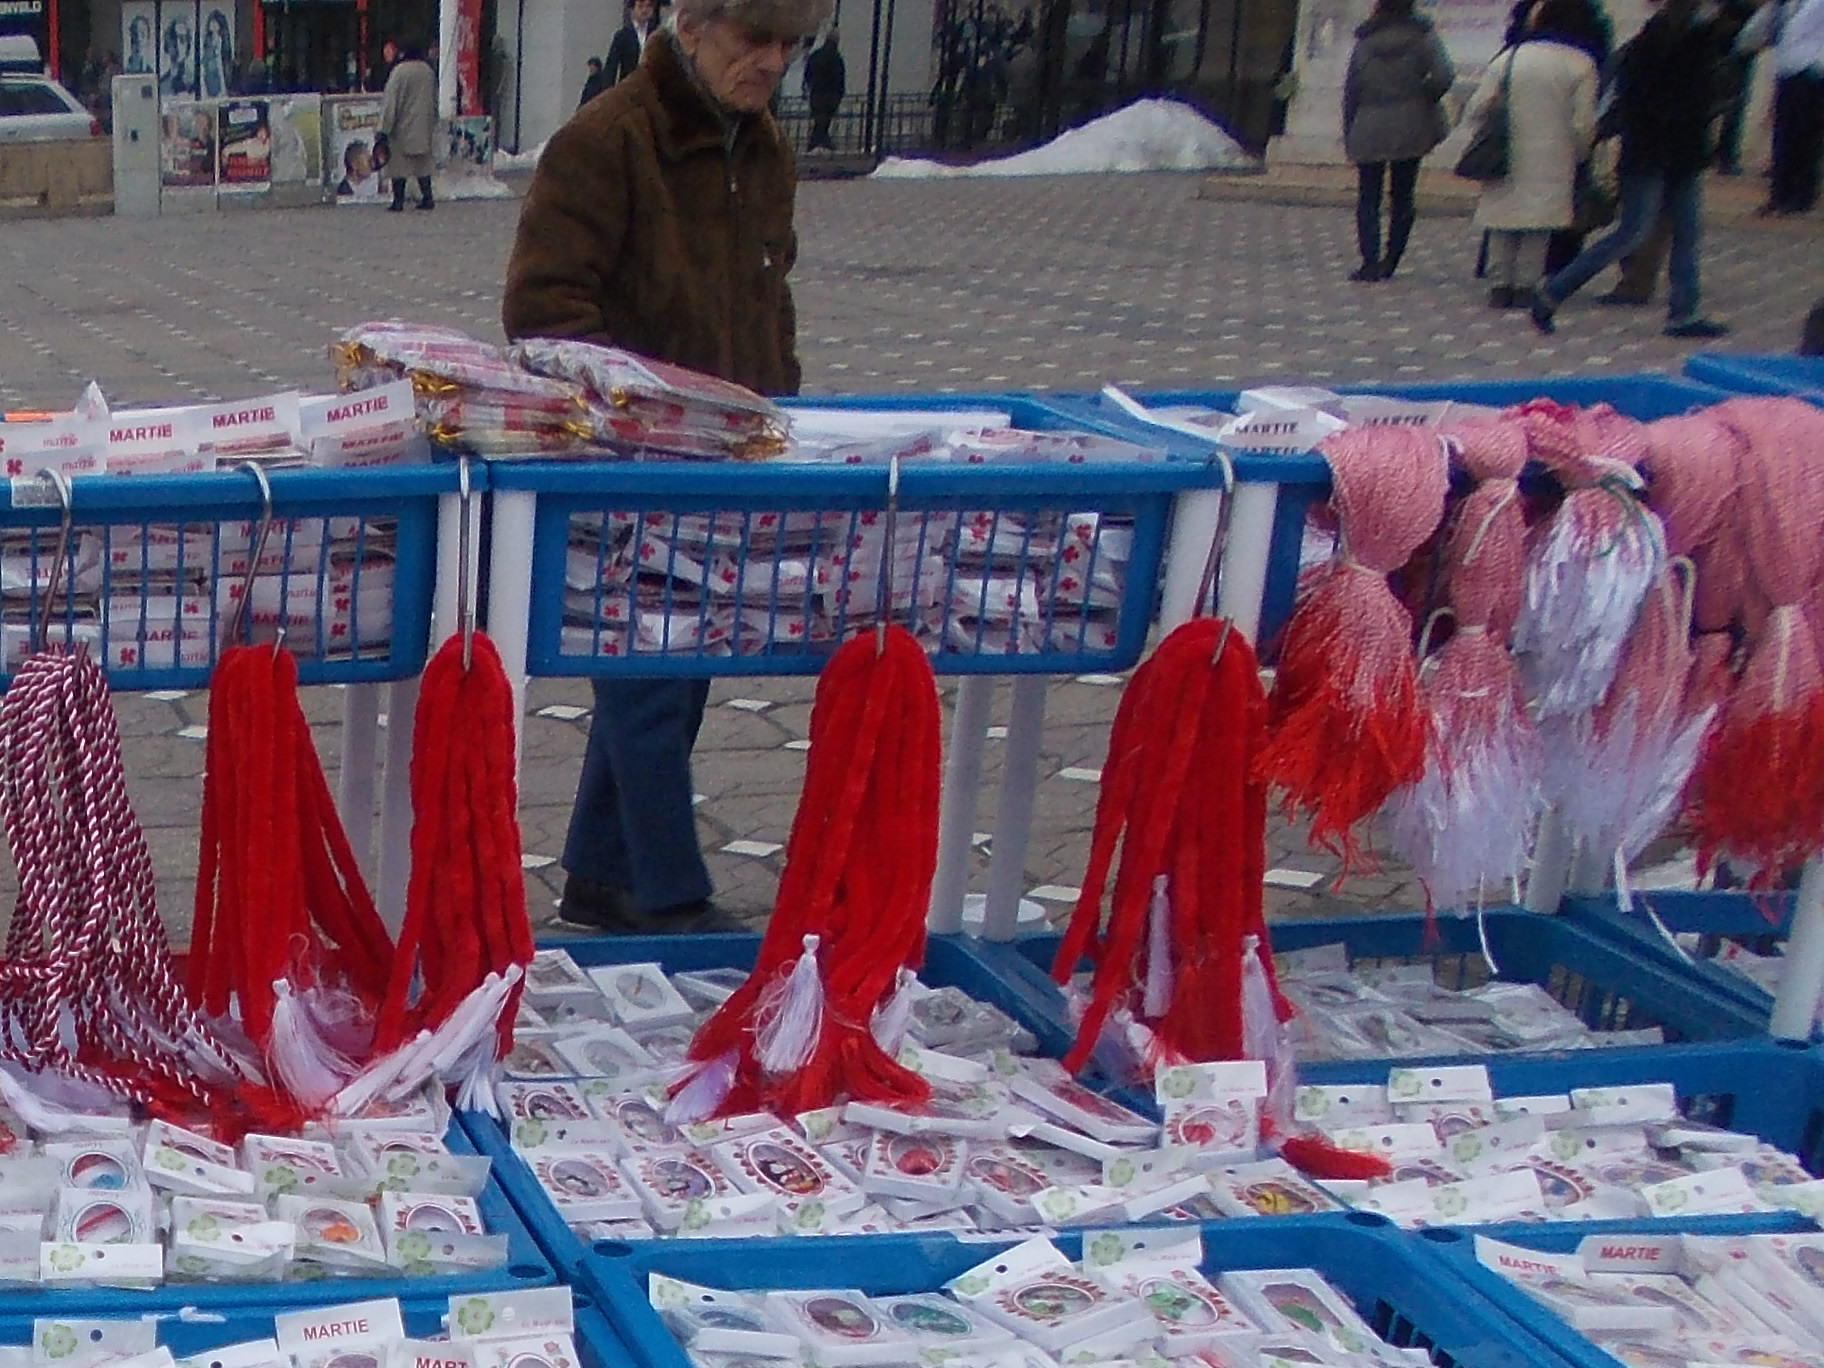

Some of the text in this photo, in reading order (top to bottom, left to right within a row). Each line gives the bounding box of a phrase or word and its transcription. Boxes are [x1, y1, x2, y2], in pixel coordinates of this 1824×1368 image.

[212, 406, 275, 428] MARTIE
[327, 396, 389, 423] MARTIE
[109, 424, 173, 442] MARTIE
[1600, 1246, 1661, 1260] MARTIE
[1499, 1256, 1560, 1274] MARTIE
[303, 1319, 369, 1341] MARTIE
